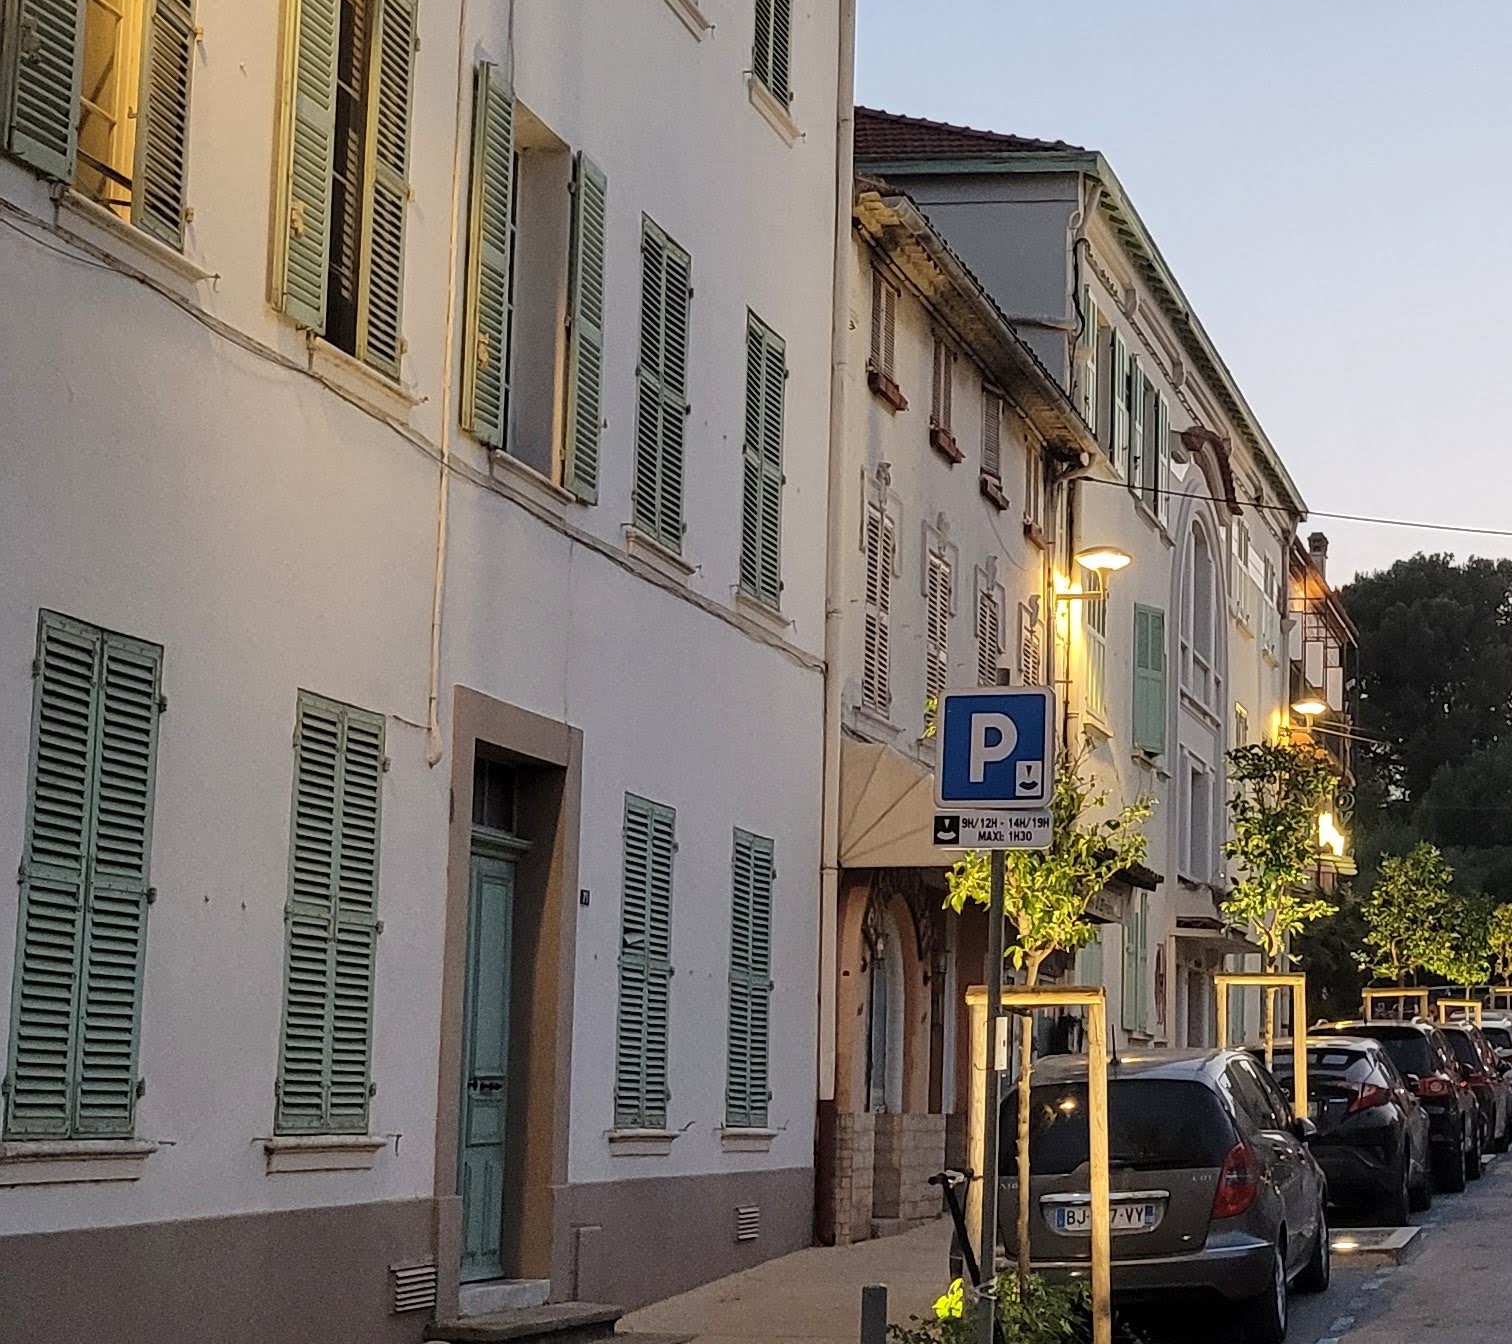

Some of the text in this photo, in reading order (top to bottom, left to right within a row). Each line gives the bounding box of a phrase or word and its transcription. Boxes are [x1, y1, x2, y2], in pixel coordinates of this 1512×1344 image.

[970, 713, 1018, 783] P
[961, 817, 998, 829] 9H/12H
[1008, 817, 1050, 829] 14H/19H
[1008, 831, 1033, 842] 1H30
[1066, 1207, 1144, 1226] BJ-7-VY
